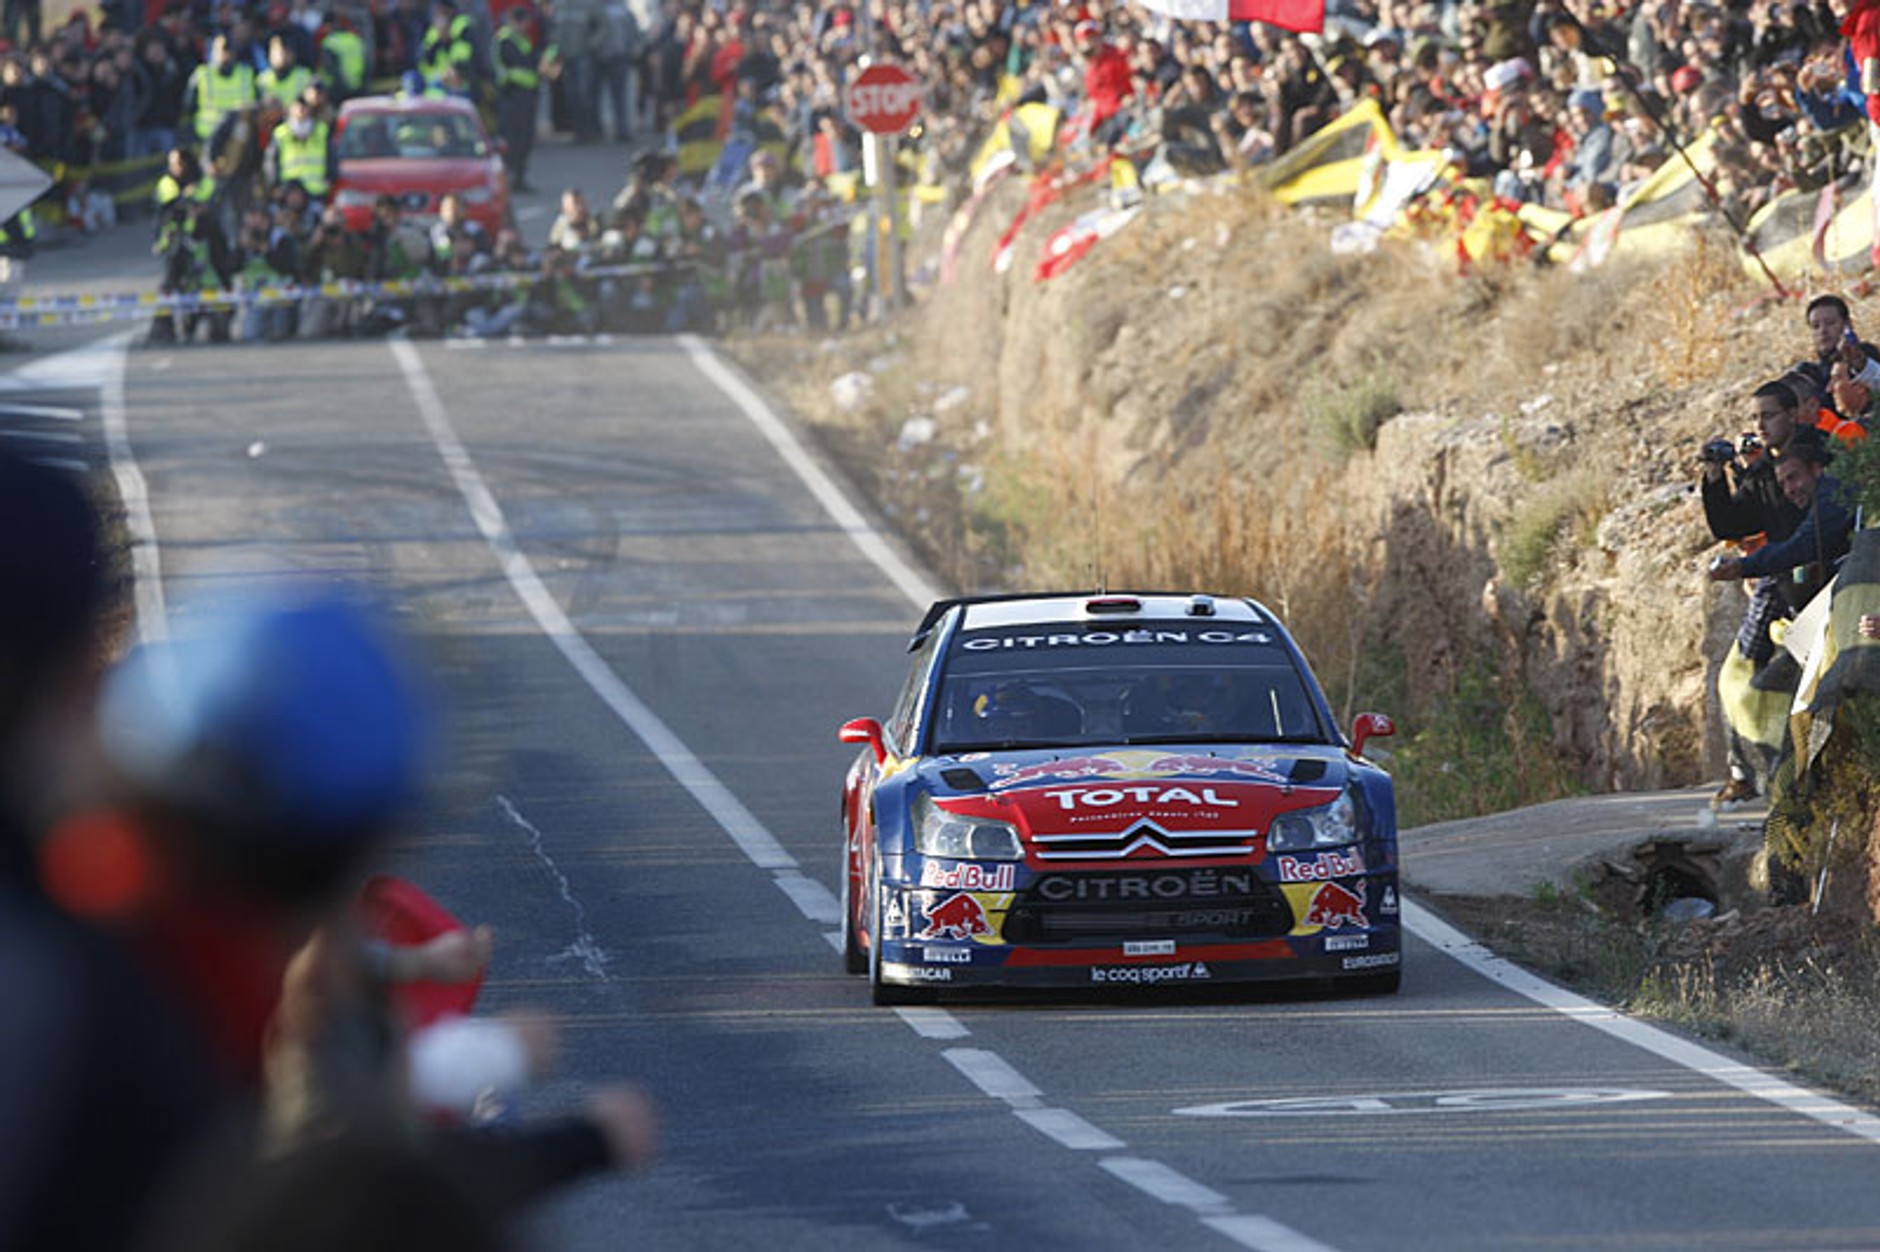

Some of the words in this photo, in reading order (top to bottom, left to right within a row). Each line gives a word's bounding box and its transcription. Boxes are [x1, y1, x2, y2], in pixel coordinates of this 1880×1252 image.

[852, 83, 917, 116] STOP
[963, 630, 1188, 650] CITROËN
[1198, 632, 1272, 643] C4
[1043, 787, 1239, 810] TOTAL
[965, 863, 1013, 889] Bull
[1279, 854, 1329, 880] Red
[1039, 869, 1250, 899] CITROËN
[1176, 909, 1253, 927] SPORT
[1091, 966, 1105, 981] le
[1108, 968, 1140, 984] coq
[1142, 963, 1191, 984] sportif
